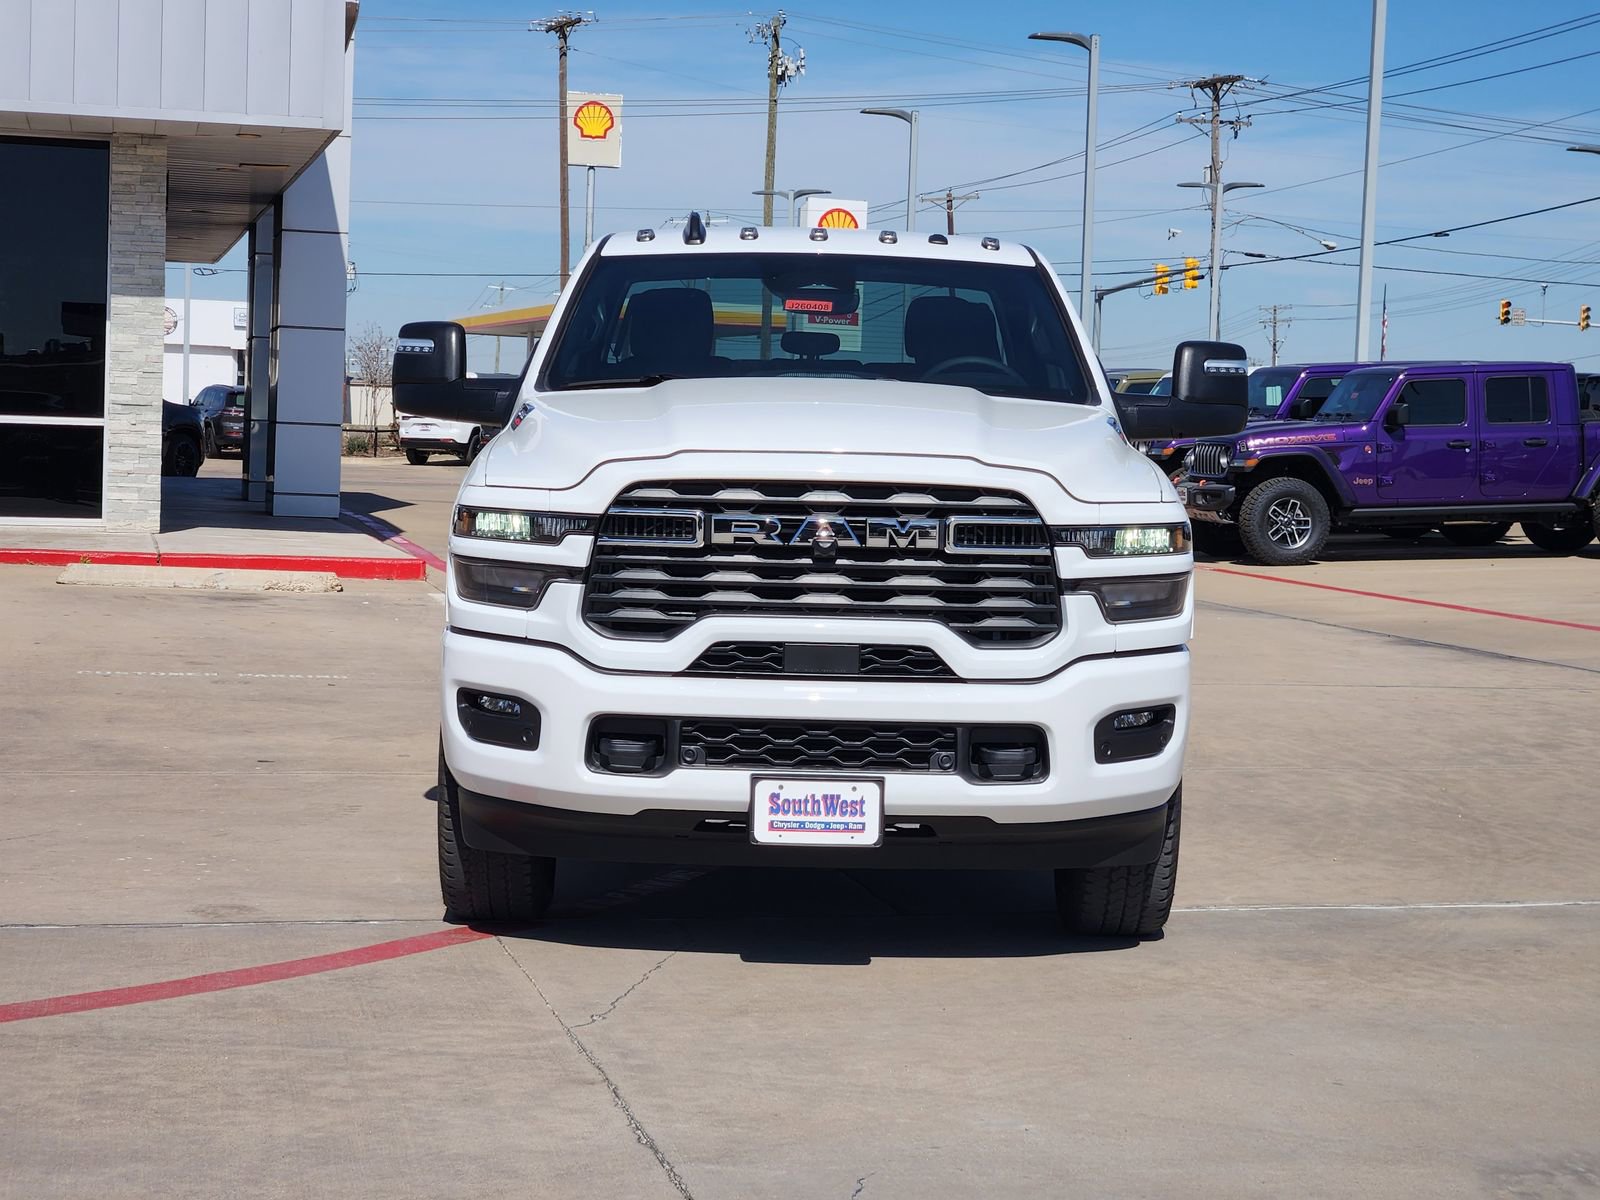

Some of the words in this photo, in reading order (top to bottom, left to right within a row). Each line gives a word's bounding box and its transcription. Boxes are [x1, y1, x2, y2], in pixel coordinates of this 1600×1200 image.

[789, 302, 829, 311] J260408
[1353, 477, 1373, 486] Jeep
[711, 515, 939, 548] RAM
[768, 791, 865, 817] SouthWest
[773, 820, 799, 830] Chrysler
[805, 822, 825, 830] Dodge
[830, 822, 845, 831] Jeep
[848, 822, 863, 830] Ram
